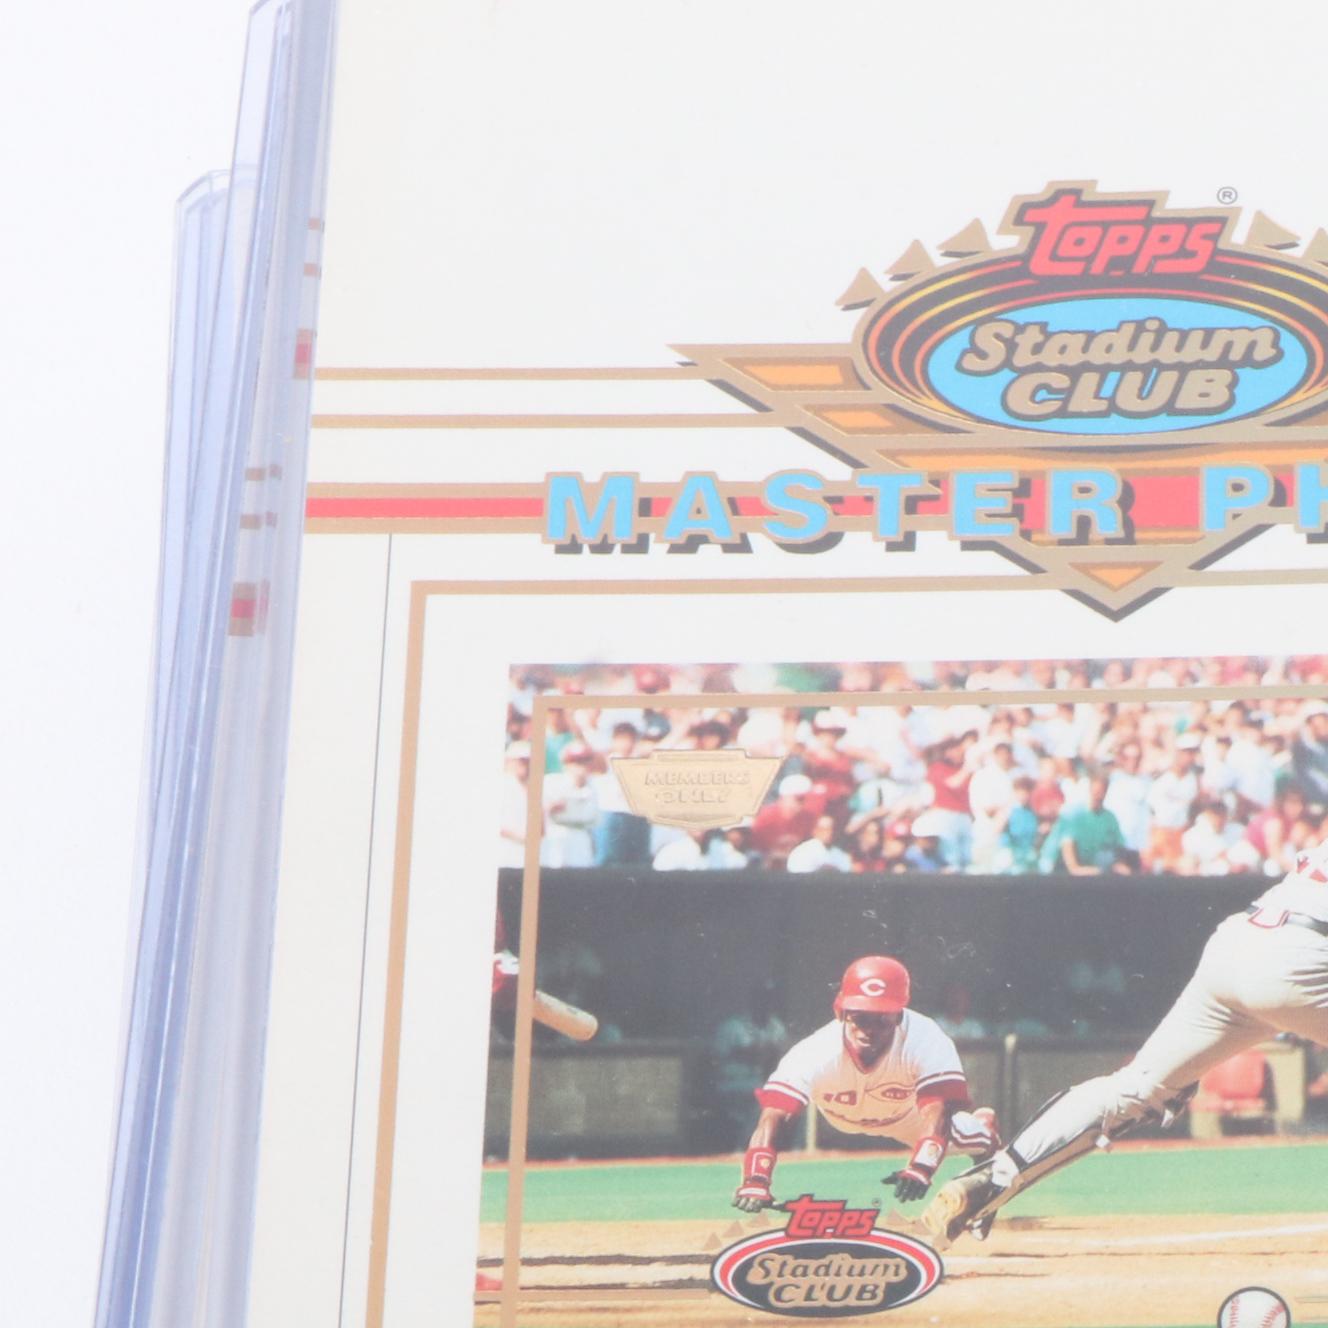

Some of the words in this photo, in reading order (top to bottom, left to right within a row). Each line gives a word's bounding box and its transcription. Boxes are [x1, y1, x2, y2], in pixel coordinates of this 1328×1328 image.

[956, 317, 1283, 376] Stadium
[1003, 368, 1237, 419] CLUB
[543, 469, 1125, 544] MASTER
[751, 1252, 905, 1283] Stadium
[770, 1282, 882, 1305] CLUB
